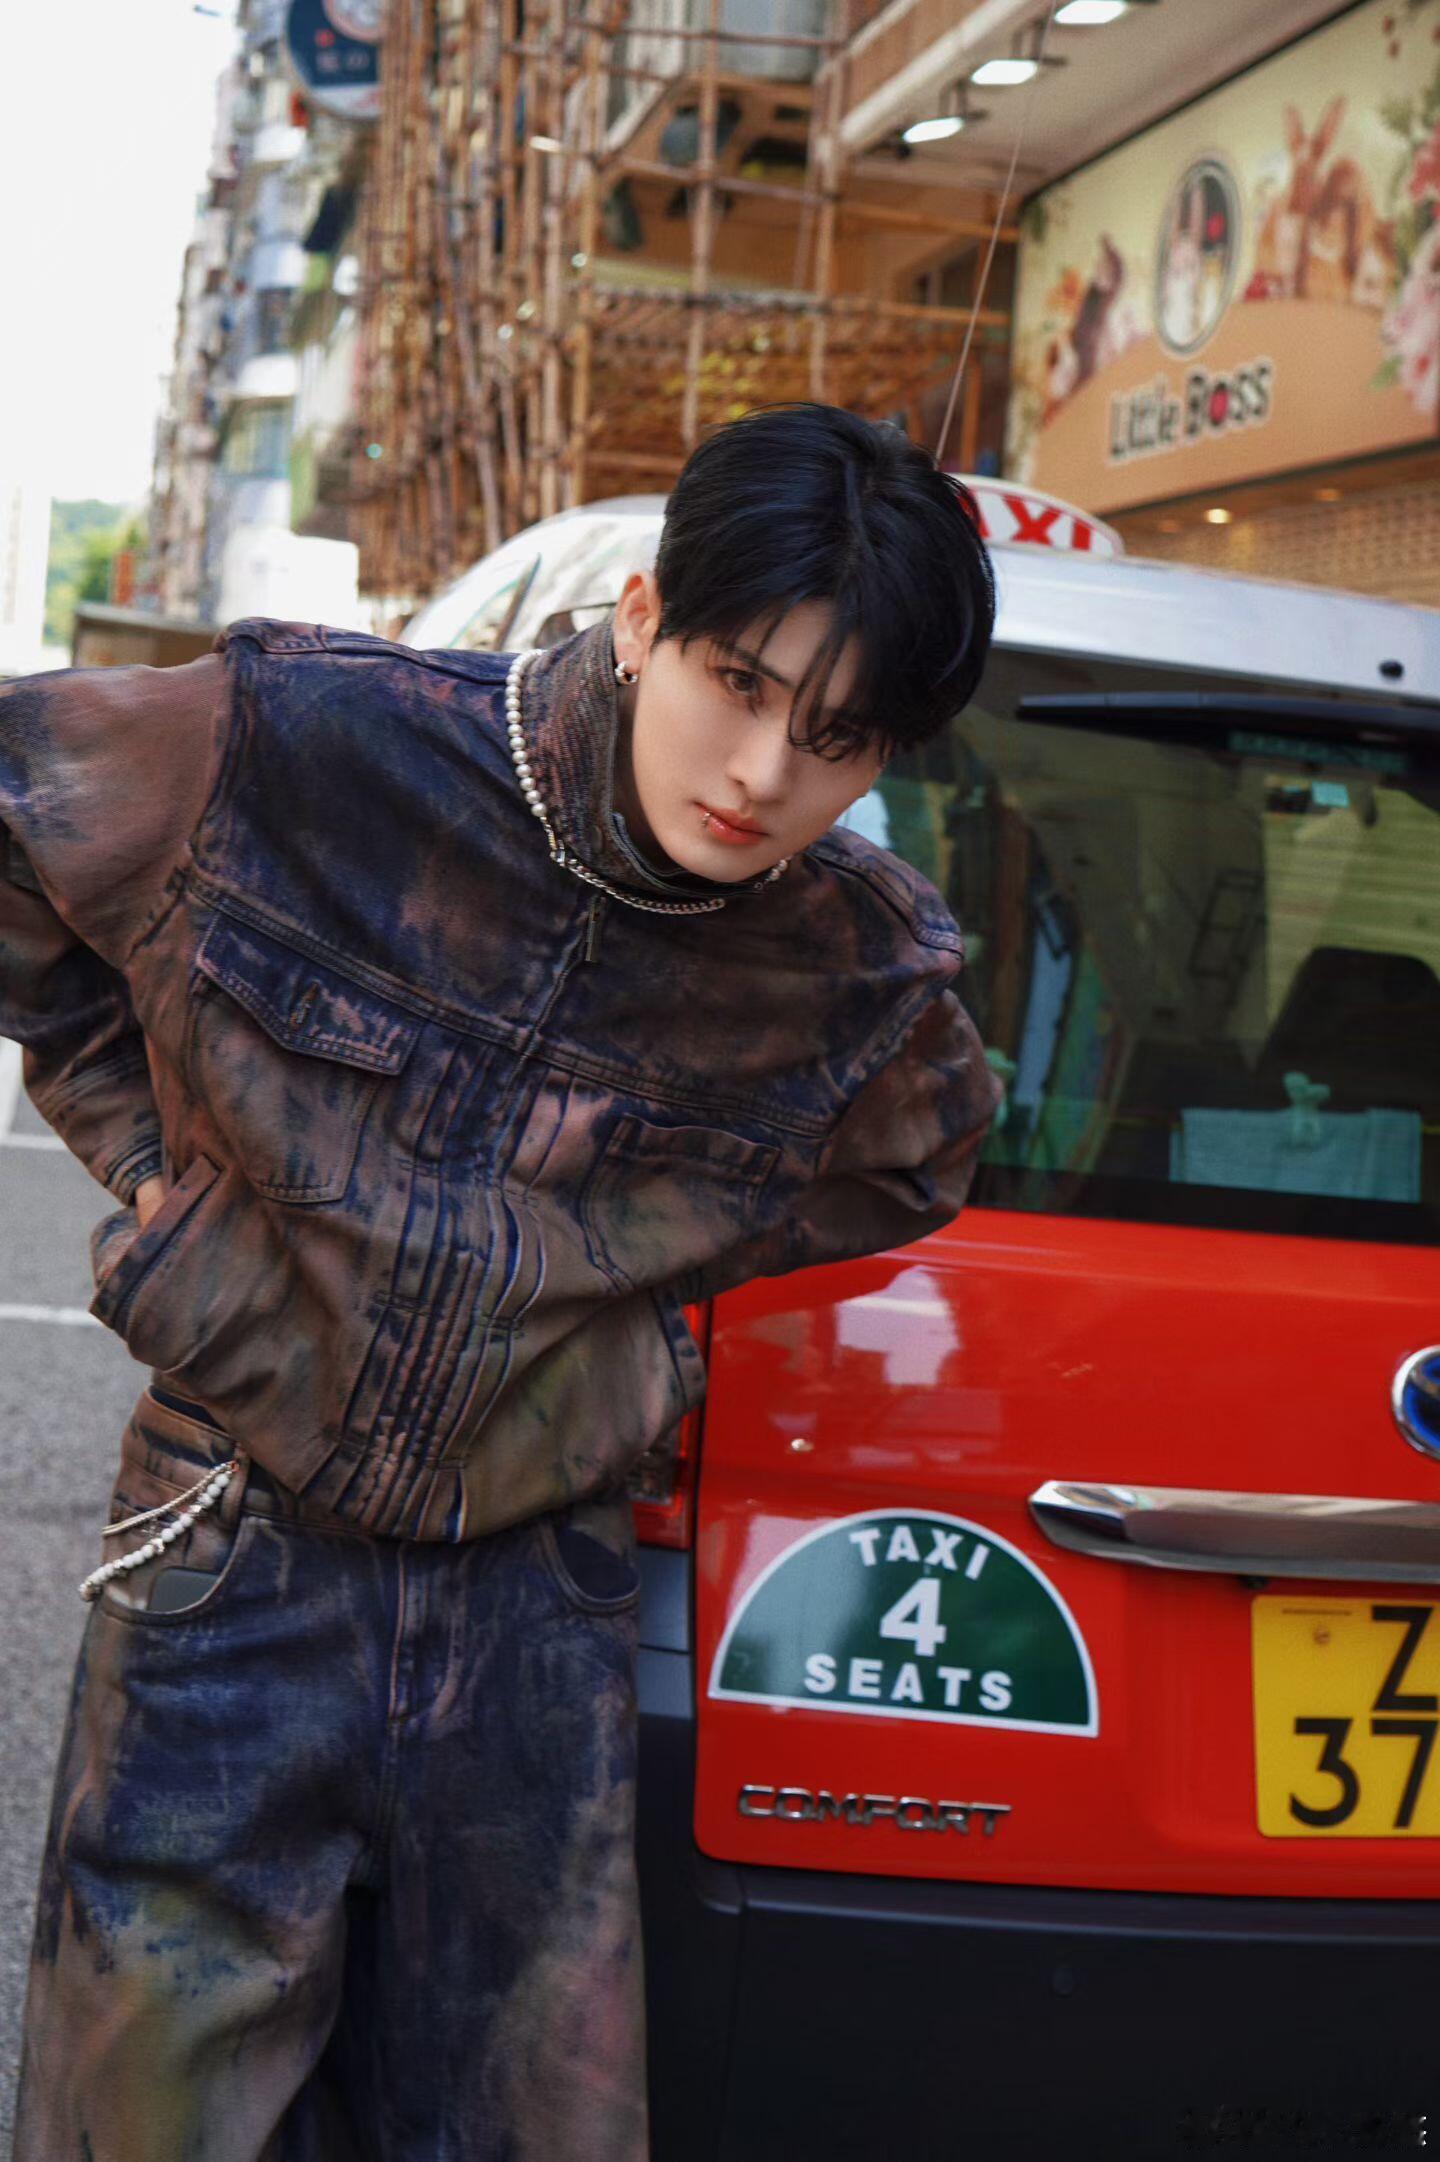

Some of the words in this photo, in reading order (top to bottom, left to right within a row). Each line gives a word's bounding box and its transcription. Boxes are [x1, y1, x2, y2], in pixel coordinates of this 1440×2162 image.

[850, 1525, 989, 1580] TAXI
[880, 1577, 947, 1656] 4
[804, 1653, 1012, 1711] SEATS
[1371, 1605, 1438, 1711] Z
[1289, 1716, 1439, 1829] 37
[738, 1784, 1012, 1836] COMFORT
